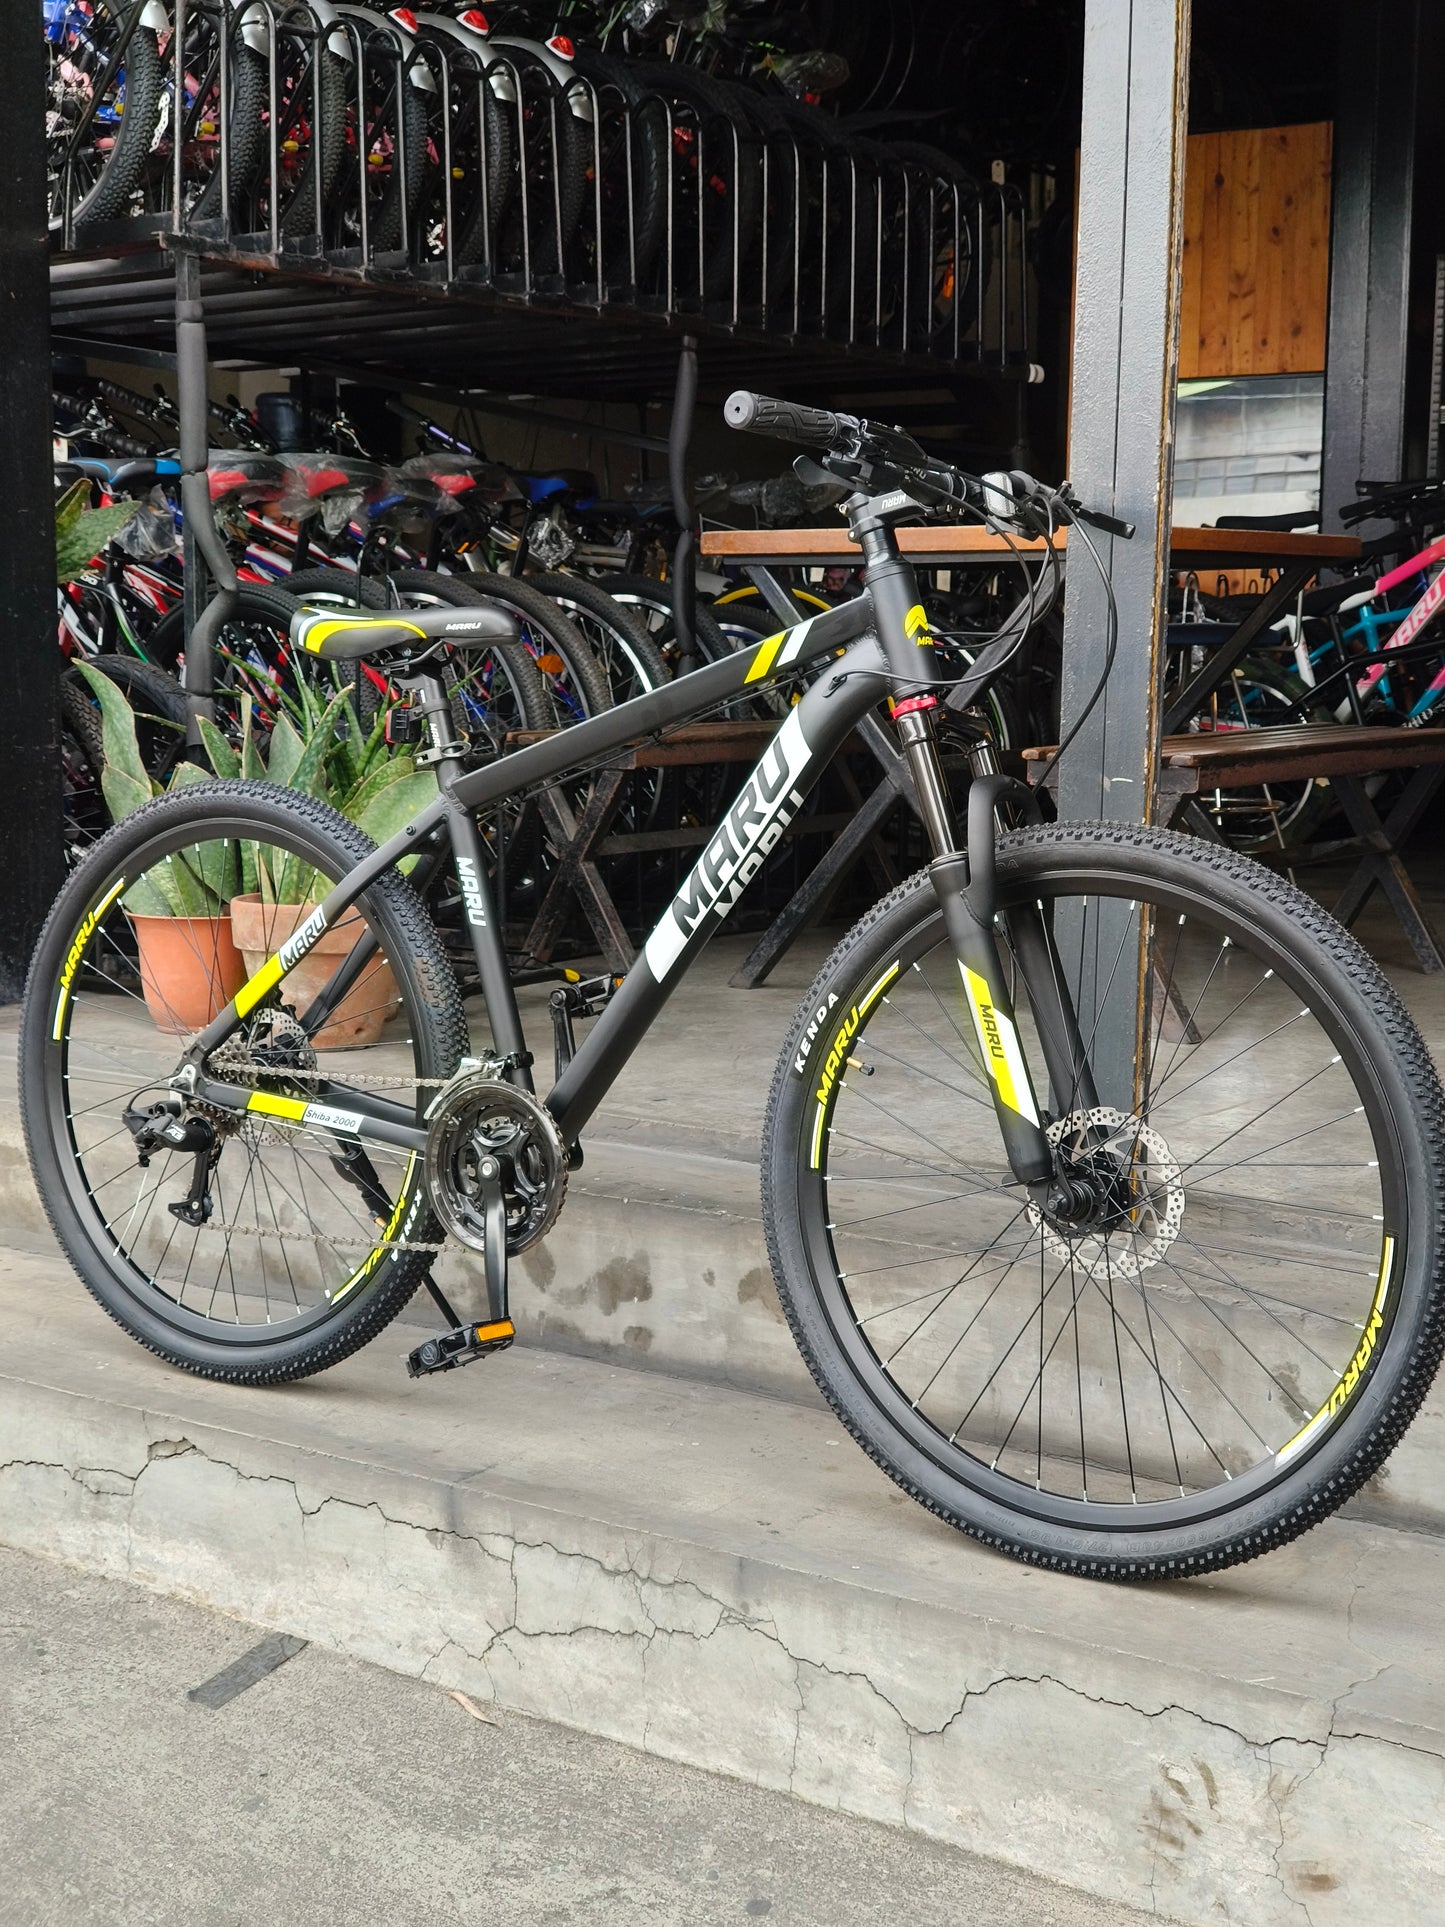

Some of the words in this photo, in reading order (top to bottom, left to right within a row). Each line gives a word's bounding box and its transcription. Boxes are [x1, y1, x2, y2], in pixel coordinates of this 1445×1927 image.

[881, 493, 907, 510] MARU
[445, 622, 482, 631] MARU
[672, 735, 790, 940] MARU
[456, 856, 487, 927] MARU
[60, 911, 96, 990] MARU
[282, 911, 325, 970] MARU
[794, 992, 839, 1074] KENDA
[816, 1005, 860, 1105] MARU
[979, 1003, 1005, 1059] MARU
[305, 1109, 331, 1122] Shiba
[332, 1115, 356, 1128] 2000
[1329, 1307, 1384, 1418] MARU
